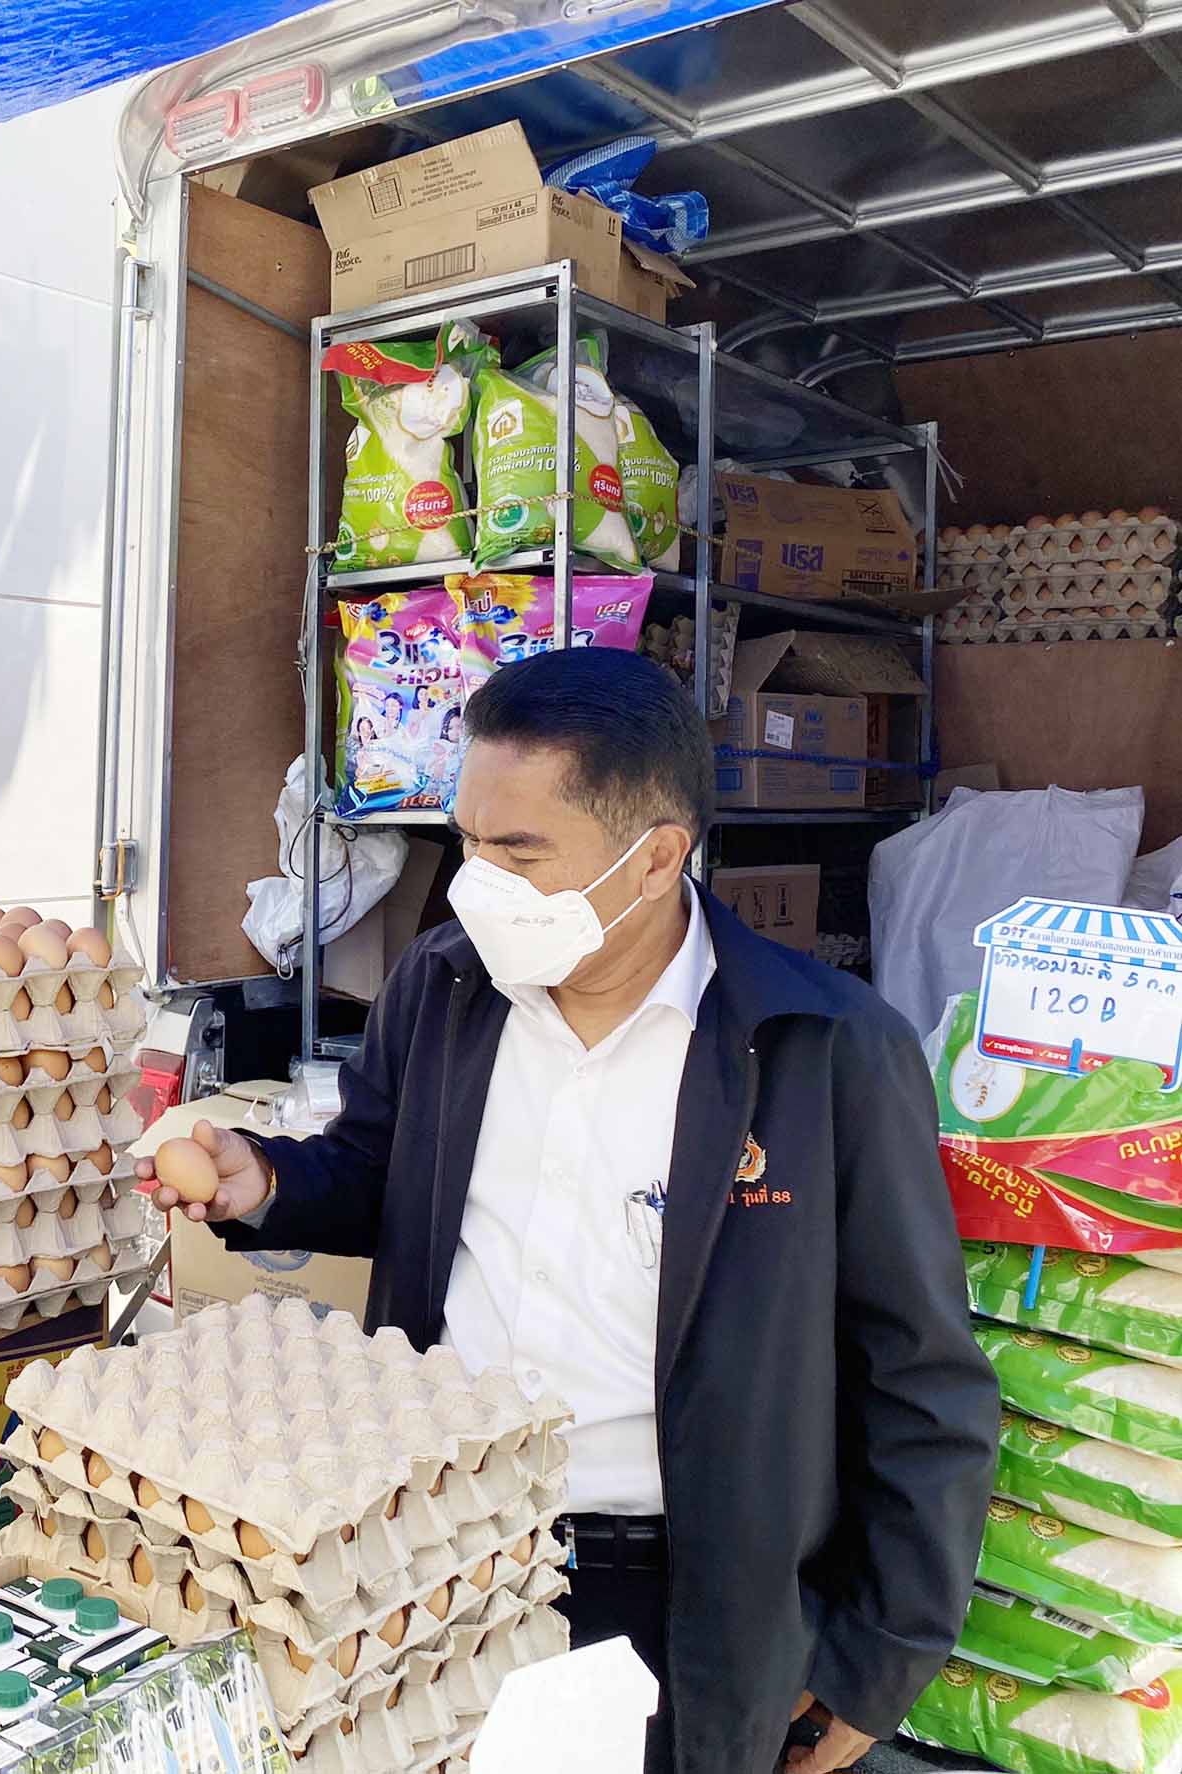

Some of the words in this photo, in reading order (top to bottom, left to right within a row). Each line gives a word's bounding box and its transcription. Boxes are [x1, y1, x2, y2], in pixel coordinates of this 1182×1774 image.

[537, 457, 582, 473] 10%
[1123, 972, 1140, 989] 5
[1030, 985, 1090, 1015] 120
[771, 1190, 792, 1204] 88
